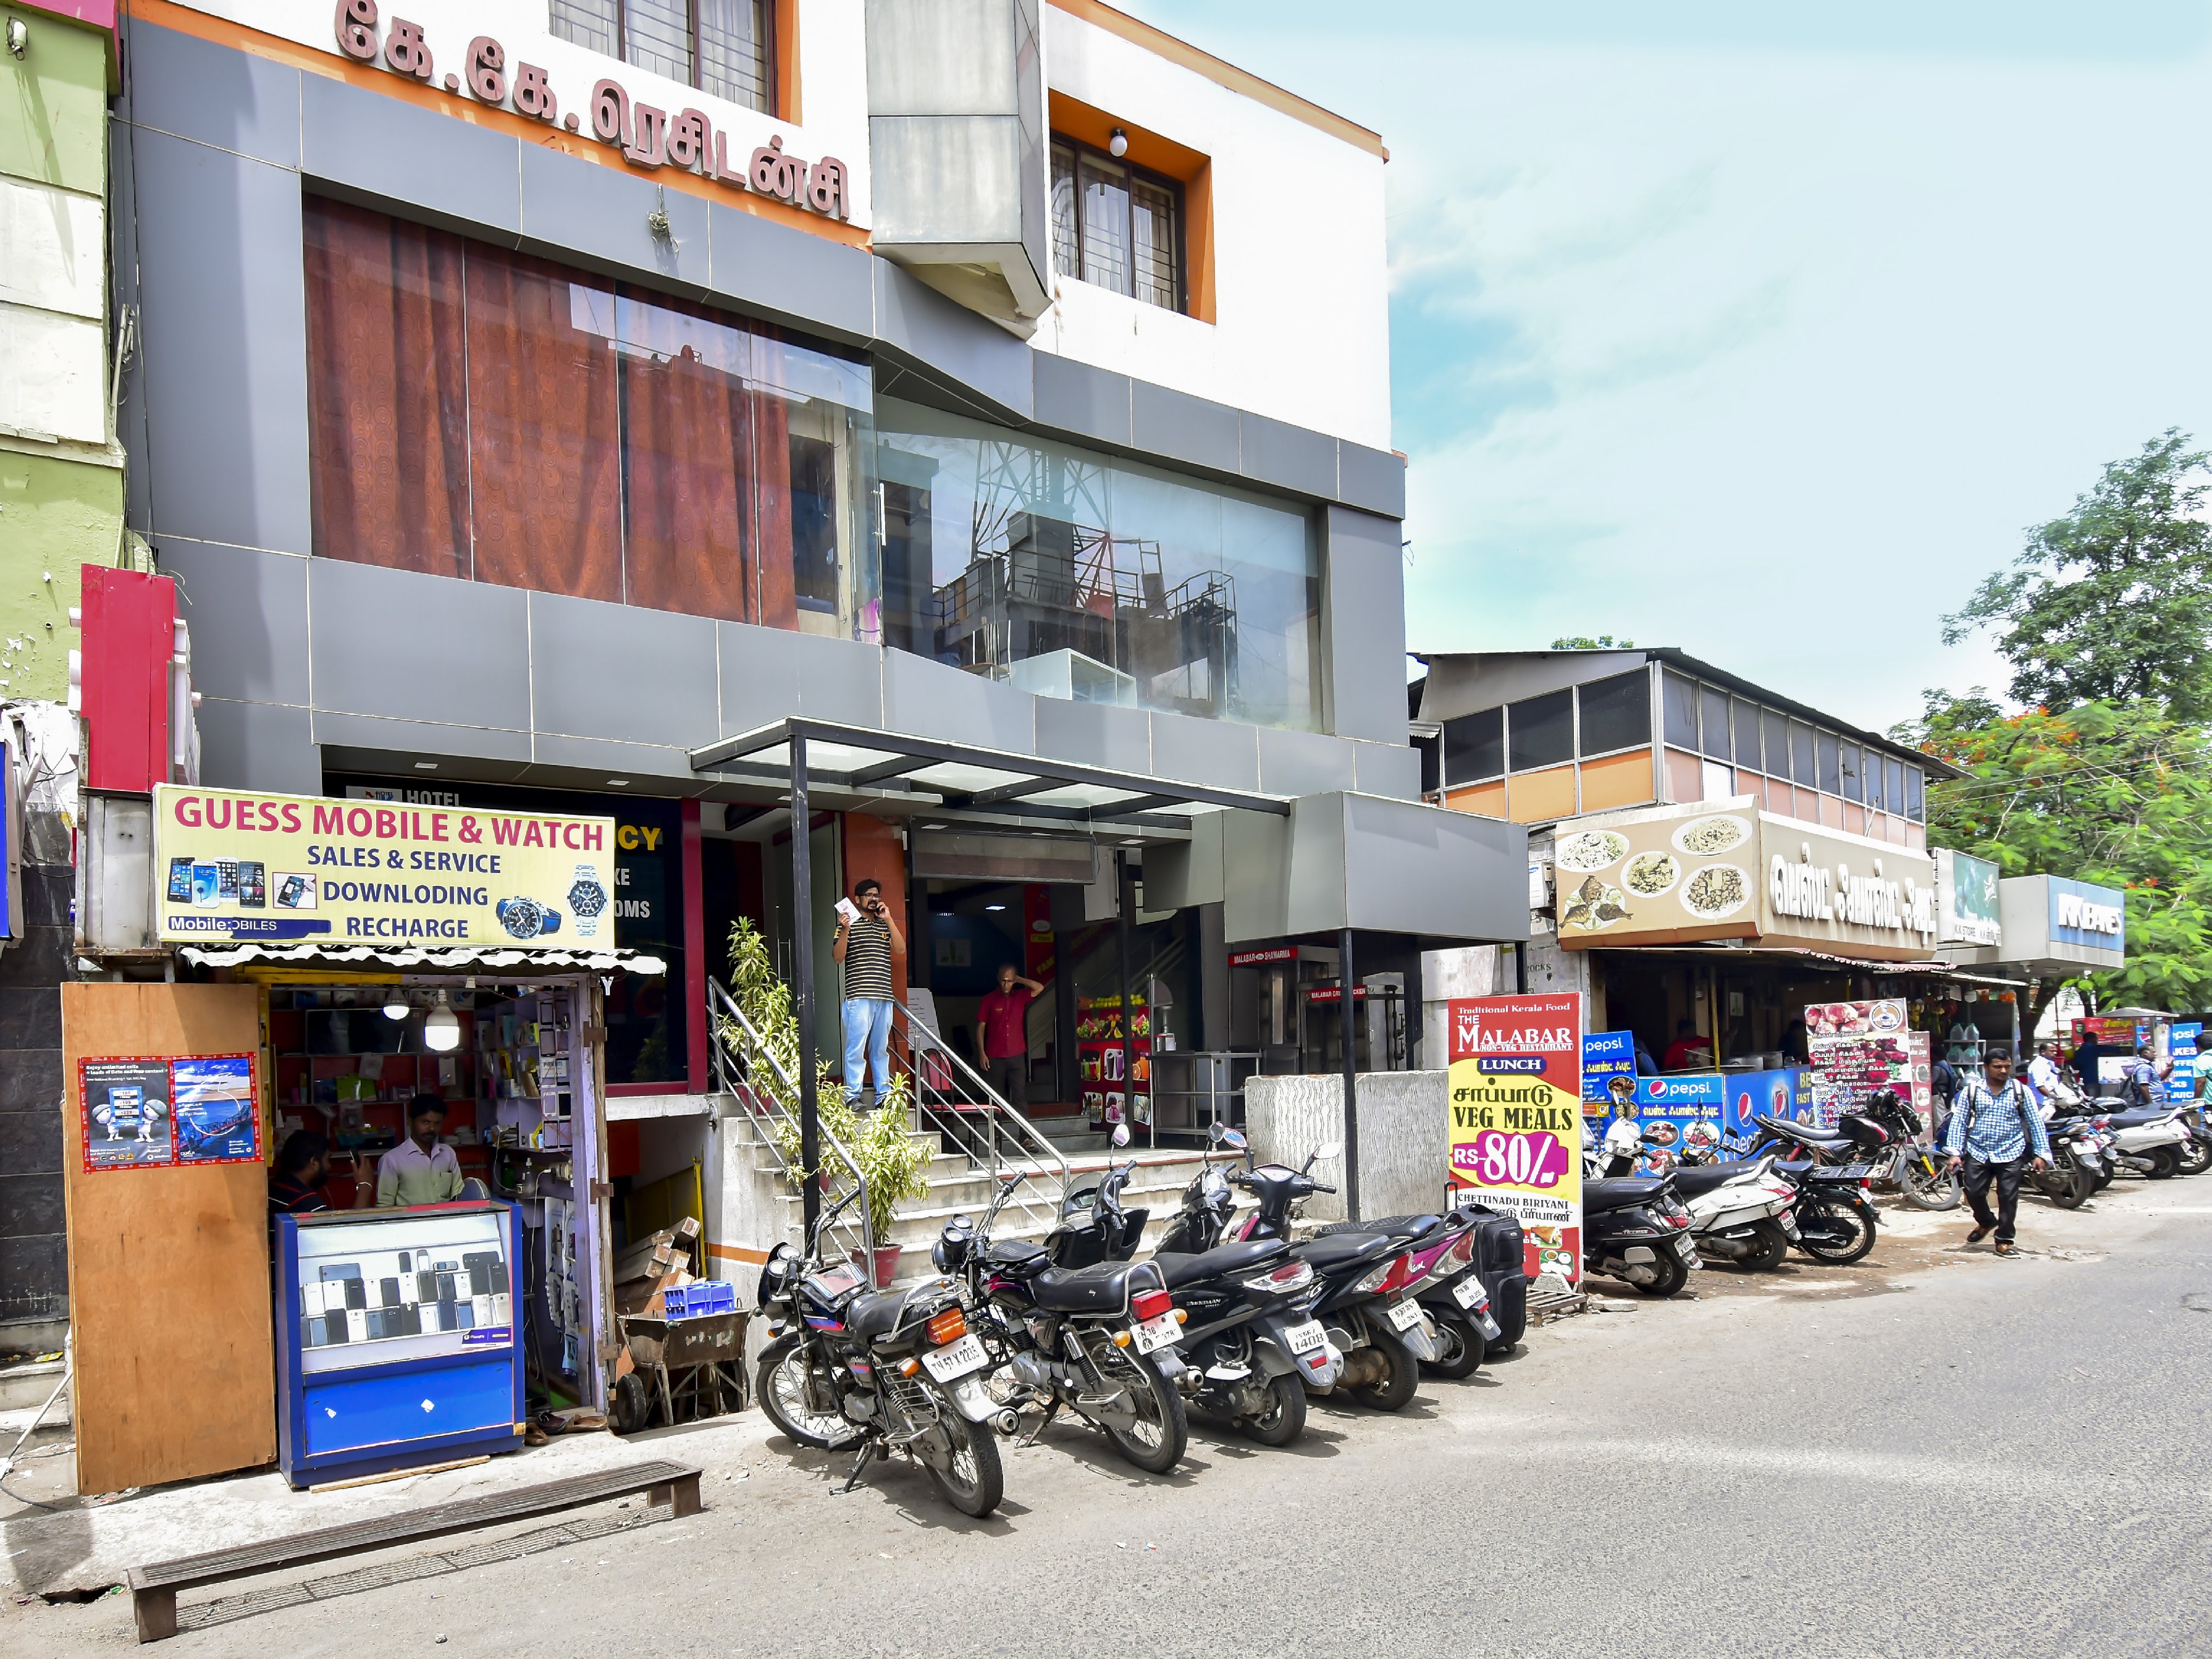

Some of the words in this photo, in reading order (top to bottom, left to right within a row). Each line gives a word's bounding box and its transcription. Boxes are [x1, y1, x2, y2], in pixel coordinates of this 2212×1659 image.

[175, 796, 302, 834] GUESS
[313, 805, 448, 842] MOBILE
[458, 815, 482, 844] &
[491, 817, 602, 851] WATCH
[616, 825, 661, 851] CY
[307, 845, 381, 868] SALES
[387, 850, 404, 869] &
[410, 851, 501, 874] SERVICE
[324, 881, 488, 906] DOWNLODING
[347, 917, 468, 939] RECHARGE
[1234, 953, 1255, 964] MALABAR
[1264, 949, 1290, 960] SHAWARMA
[1457, 1005, 1508, 1015] Traditional
[1512, 1003, 1542, 1013] Kerala
[1545, 1002, 1570, 1011] Food
[1457, 1015, 1479, 1024] THE
[1457, 1024, 1573, 1052] MALABAR
[2172, 1029, 2196, 1041] psi
[1520, 1042, 1573, 1051] RESTAURANT
[1482, 1059, 1542, 1070] LUNCH
[1799, 1071, 1812, 1088] BE
[1453, 1077, 1552, 1106] சாப்பாடு
[1670, 1081, 1712, 1097] pepsi
[1796, 1092, 1810, 1105] FAST
[1454, 1108, 1493, 1128] VEG
[1504, 1108, 1572, 1130] MEALS
[1458, 1193, 1520, 1206] CHETTINADU
[1523, 1198, 1570, 1210] BIRIYANI
